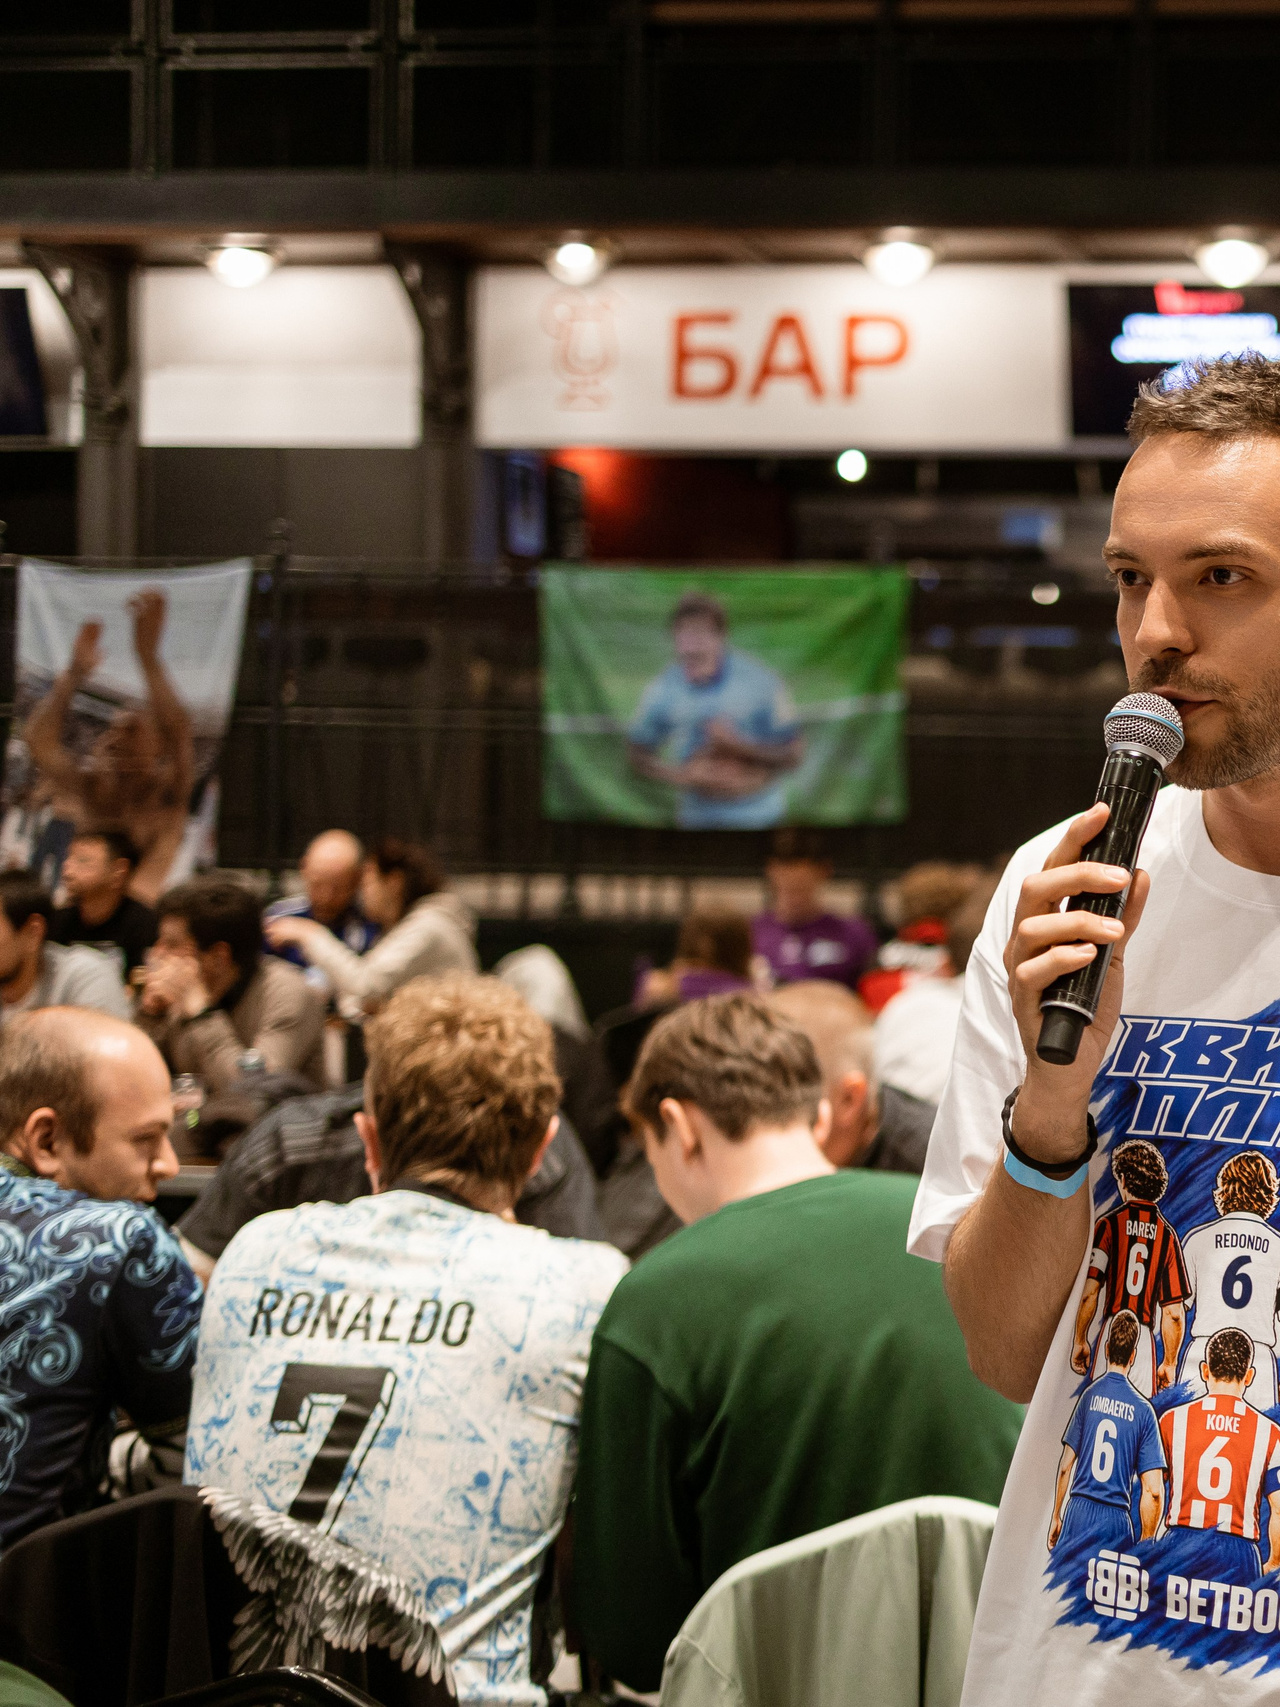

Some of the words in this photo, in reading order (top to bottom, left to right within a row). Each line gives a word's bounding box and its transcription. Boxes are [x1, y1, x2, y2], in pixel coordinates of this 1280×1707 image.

[673, 313, 909, 400] БАР
[1125, 1219, 1157, 1241] BARESI
[1215, 1233, 1270, 1254] REDONDO
[1126, 1242, 1149, 1297] 6
[1221, 1255, 1253, 1310] 6
[249, 1288, 475, 1348] RONALDO
[1089, 1395, 1135, 1422] LOMBAERTS
[1205, 1413, 1241, 1434] KOKE
[270, 1362, 398, 1536] 7
[1091, 1418, 1118, 1483] 6
[1197, 1435, 1233, 1501] 6
